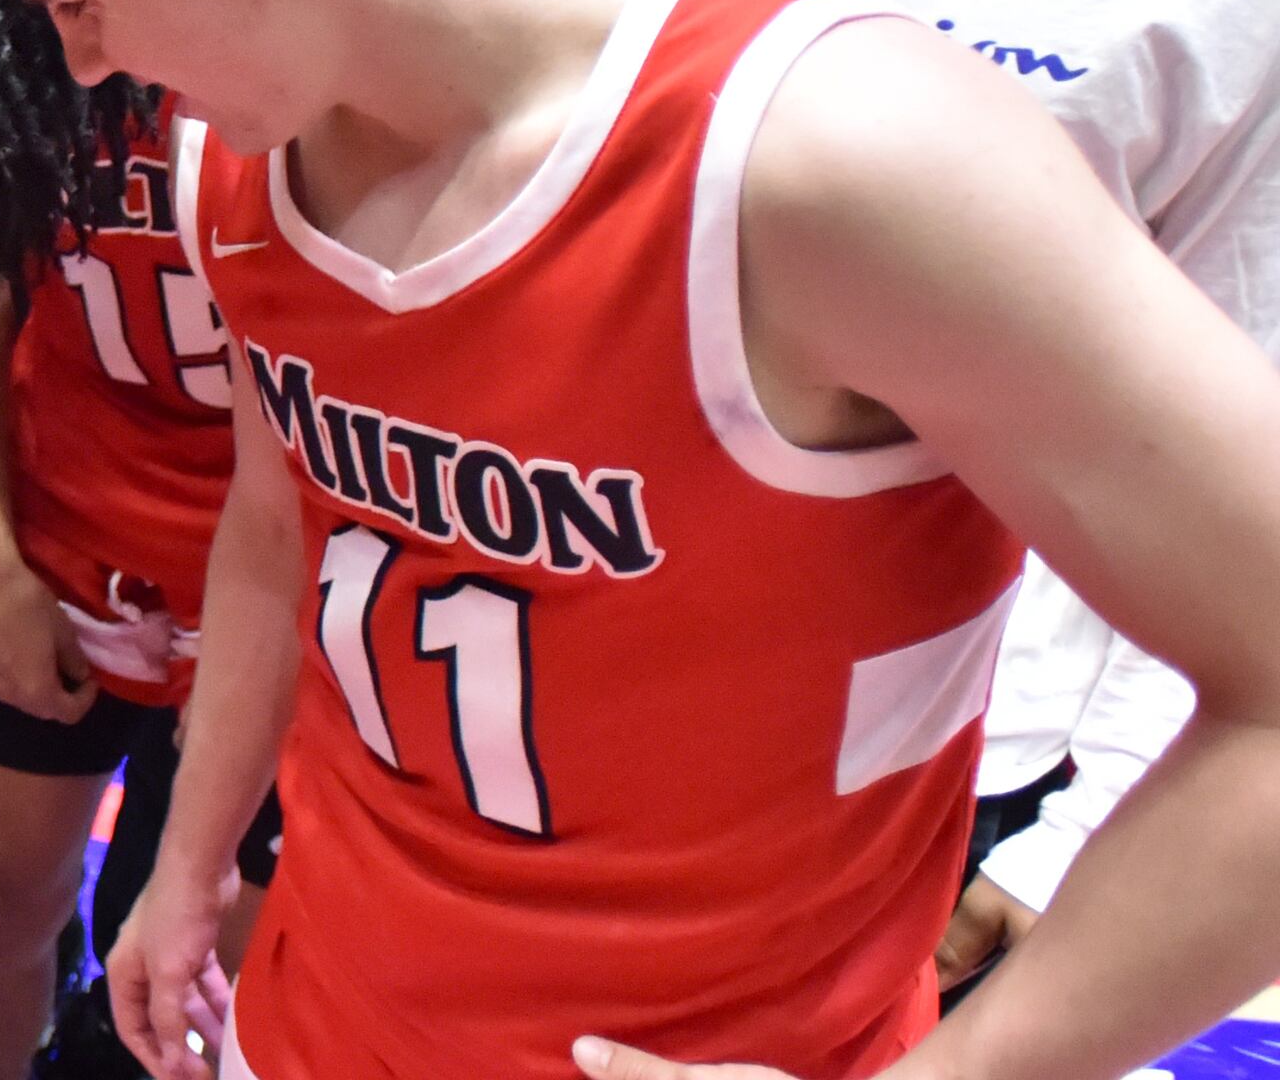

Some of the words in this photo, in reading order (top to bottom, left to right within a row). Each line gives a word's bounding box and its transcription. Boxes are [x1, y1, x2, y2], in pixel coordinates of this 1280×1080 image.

[58, 250, 233, 410] 15
[244, 336, 666, 579] MILTON
[317, 522, 554, 842] 11
